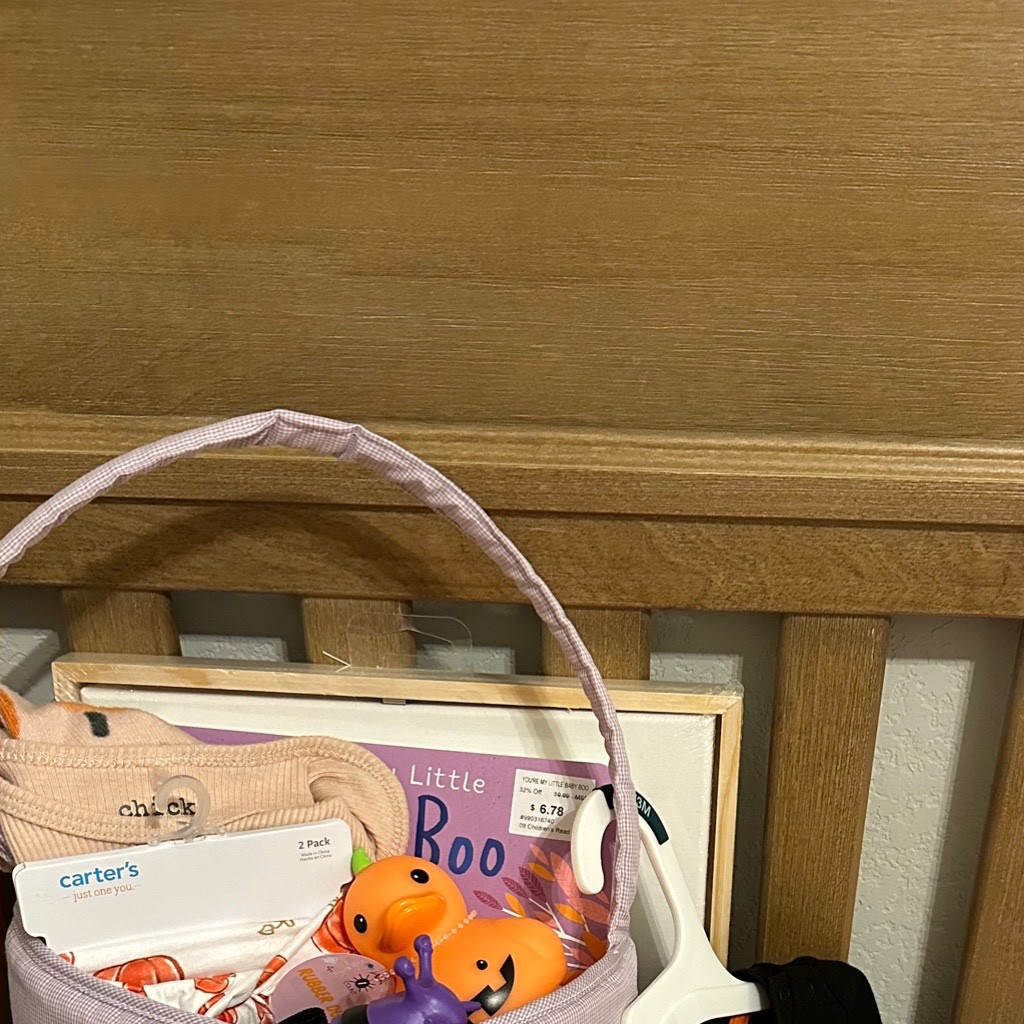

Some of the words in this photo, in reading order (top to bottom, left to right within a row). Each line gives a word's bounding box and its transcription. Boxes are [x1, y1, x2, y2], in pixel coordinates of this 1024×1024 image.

[409, 764, 486, 794] Little
[564, 782, 578, 790] BABY
[578, 784, 589, 792] BOO
[519, 786, 532, 794] 32%
[118, 795, 196, 818] chick
[539, 804, 564, 817] 6.78
[527, 823, 555, 833] Children's
[555, 827, 571, 835] Read
[298, 841, 305, 850] 2
[307, 837, 331, 848] Pack
[59, 861, 140, 889] carter's
[73, 889, 93, 903] just
[93, 887, 113, 897] one
[113, 884, 133, 897] you
[298, 968, 335, 1004] RUBBER
